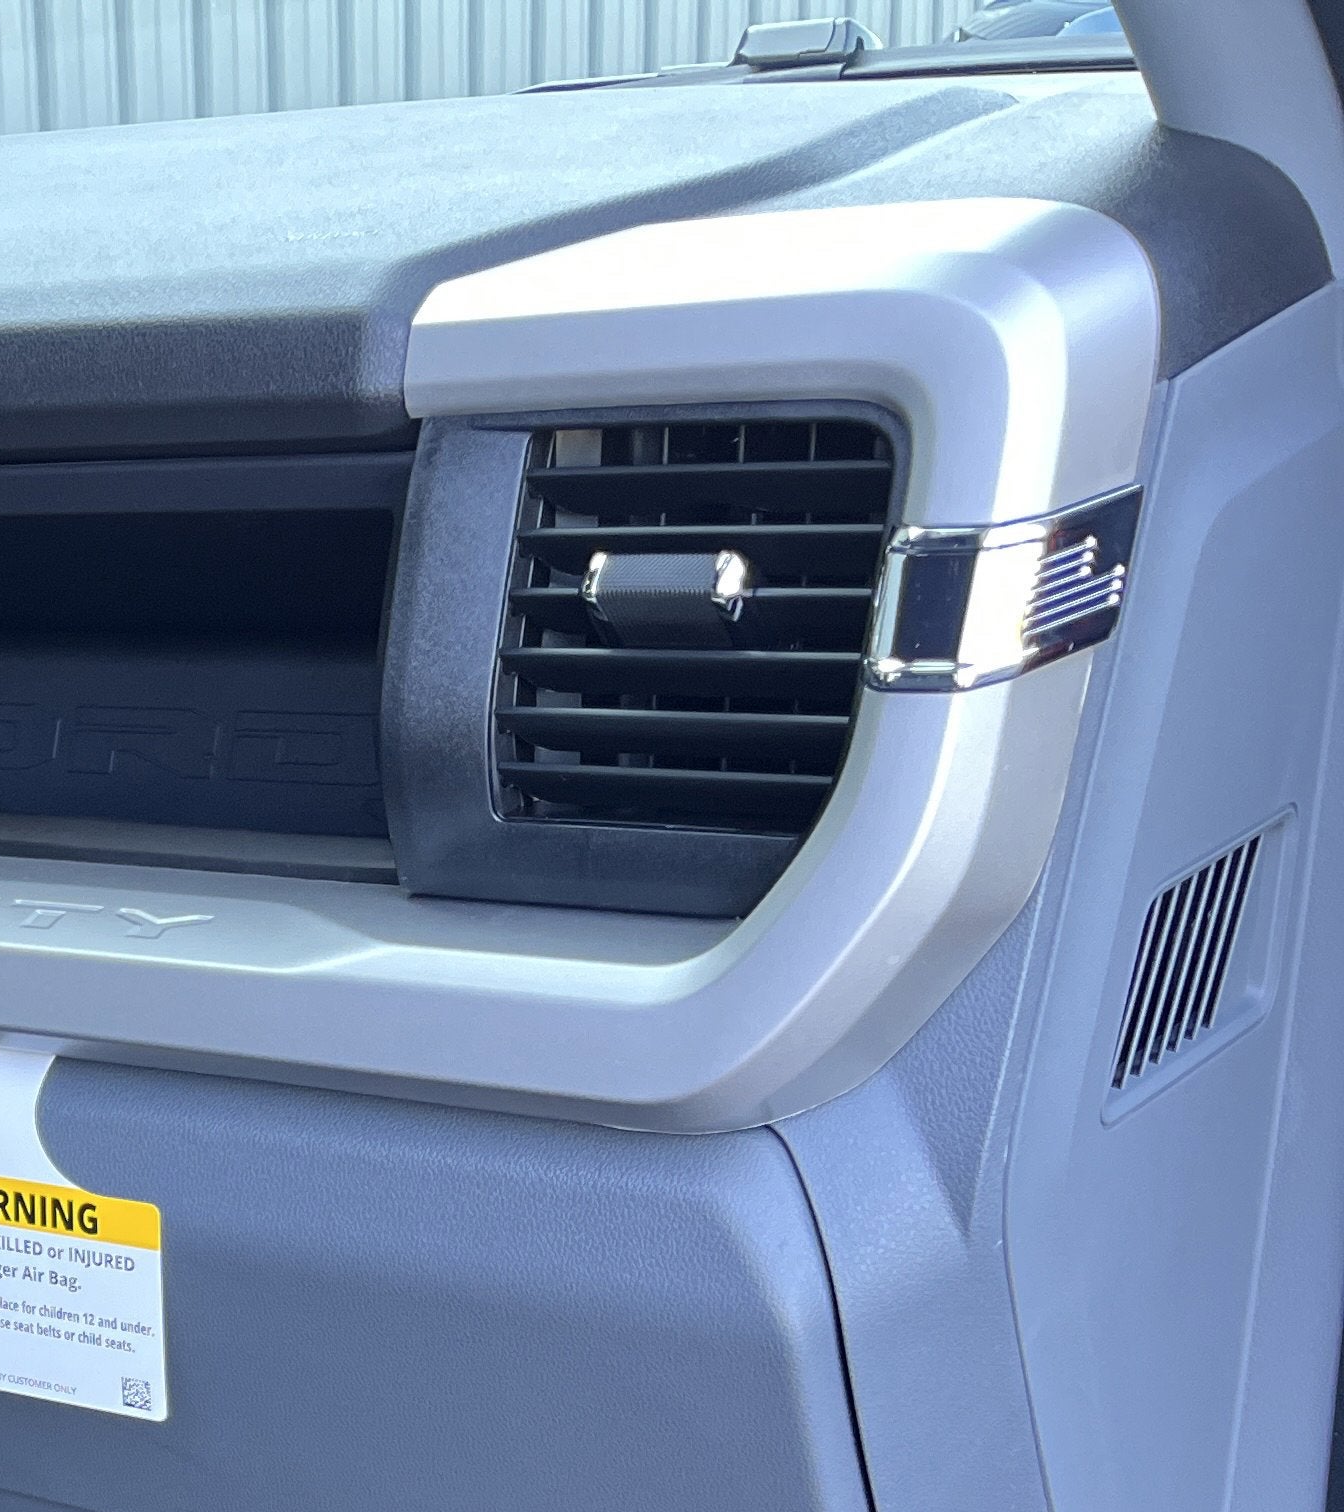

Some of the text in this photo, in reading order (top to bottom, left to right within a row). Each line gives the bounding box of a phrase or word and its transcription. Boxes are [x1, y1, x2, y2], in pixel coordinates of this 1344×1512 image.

[47, 1245, 65, 1260] or
[68, 1247, 136, 1272] INJURED
[22, 1265, 45, 1283] Air
[48, 1269, 82, 1293] Bag.
[21, 1300, 37, 1315] for
[38, 1304, 80, 1323] children
[82, 1312, 95, 1326] 12
[97, 1317, 118, 1330] and
[120, 1320, 156, 1338] under.
[13, 1319, 34, 1334] seat
[36, 1323, 62, 1339] belts
[63, 1330, 76, 1342] or
[77, 1331, 102, 1347] child
[104, 1336, 136, 1353] seats.
[7, 1374, 53, 1391] CUSTOMER
[53, 1383, 77, 1396] ONLY
